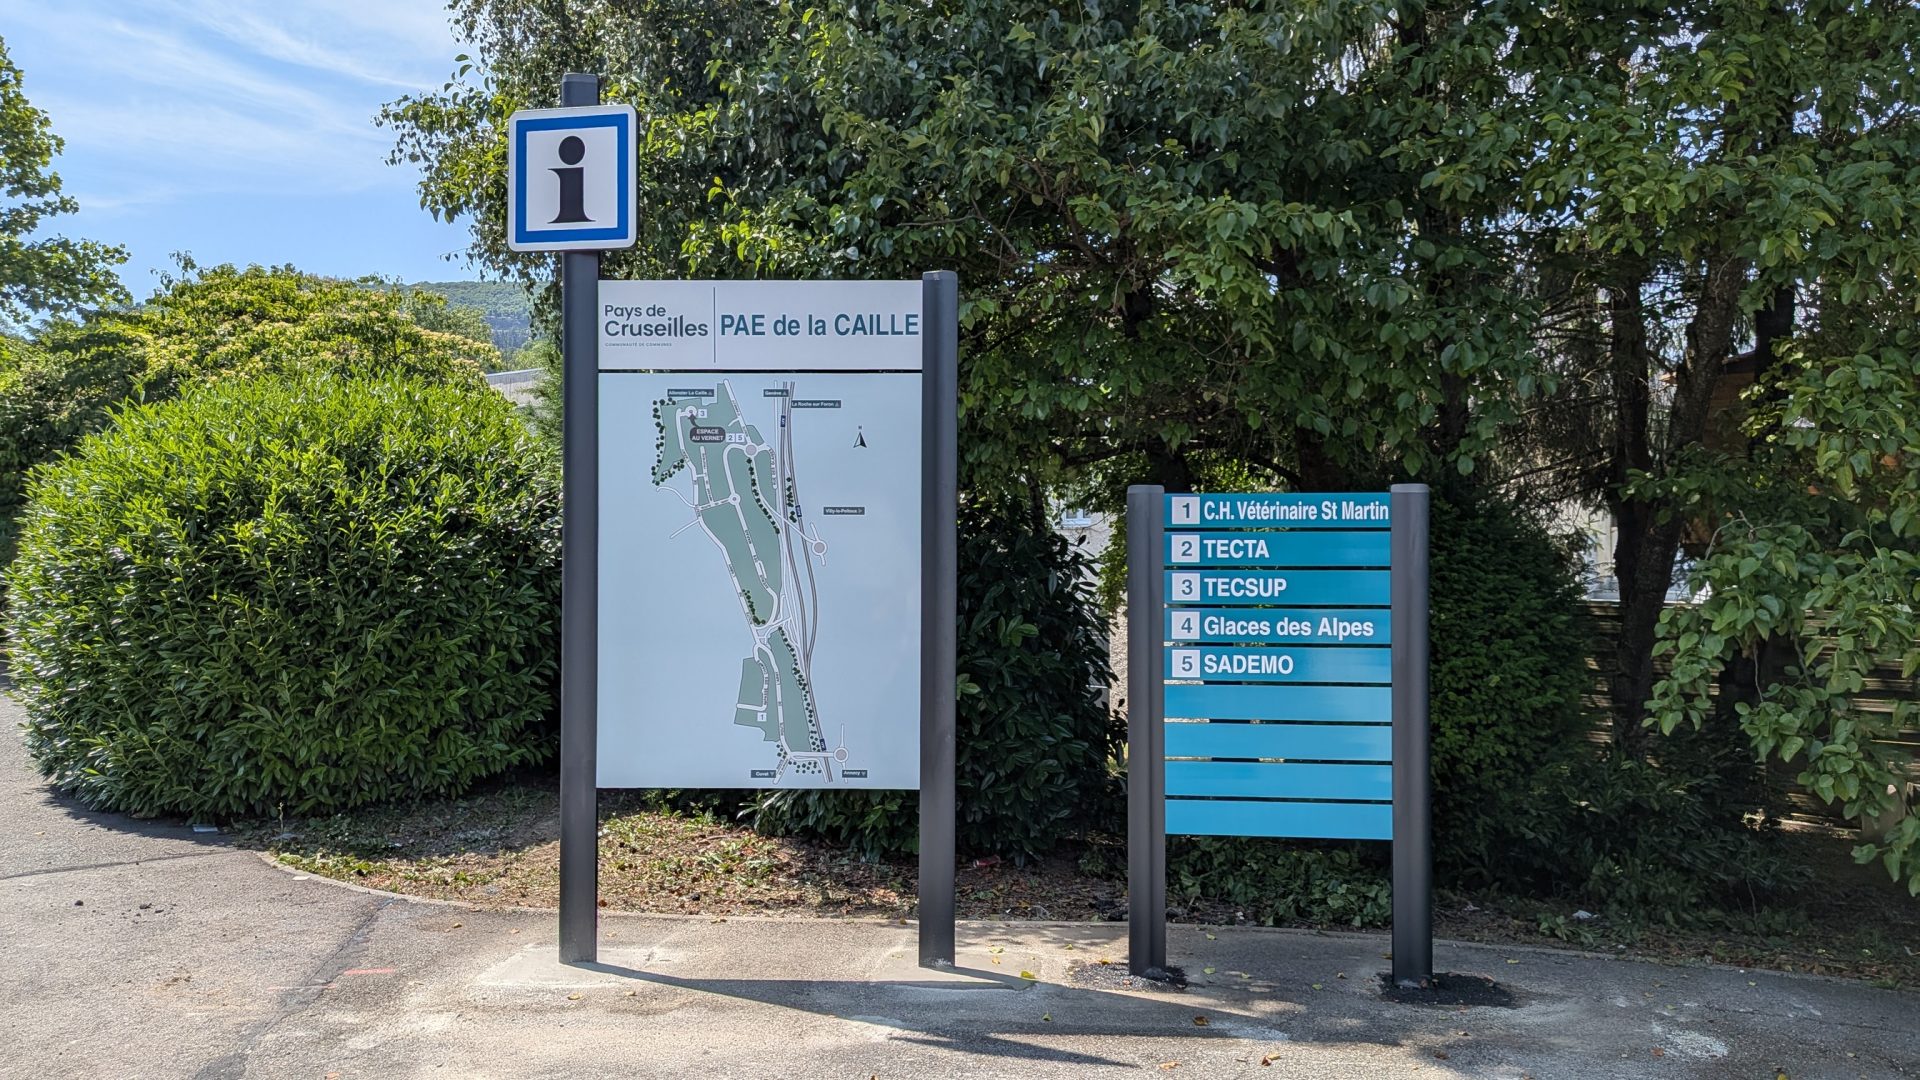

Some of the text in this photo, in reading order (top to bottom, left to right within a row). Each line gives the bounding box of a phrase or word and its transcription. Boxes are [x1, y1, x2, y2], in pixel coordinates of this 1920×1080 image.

[604, 304, 666, 321] Pays de
[604, 315, 708, 338] Cruseilles
[720, 313, 919, 336] PAE de la CAILLE
[1182, 500, 1389, 520] 1 C.H. Vétérinaire St Martin
[1181, 539, 1270, 558] 2 TECTA
[1181, 577, 1287, 597] 3 TECSUP
[1181, 616, 1375, 641] 4 Glaces des Alpes
[1181, 654, 1294, 675] 5 SADEMO
